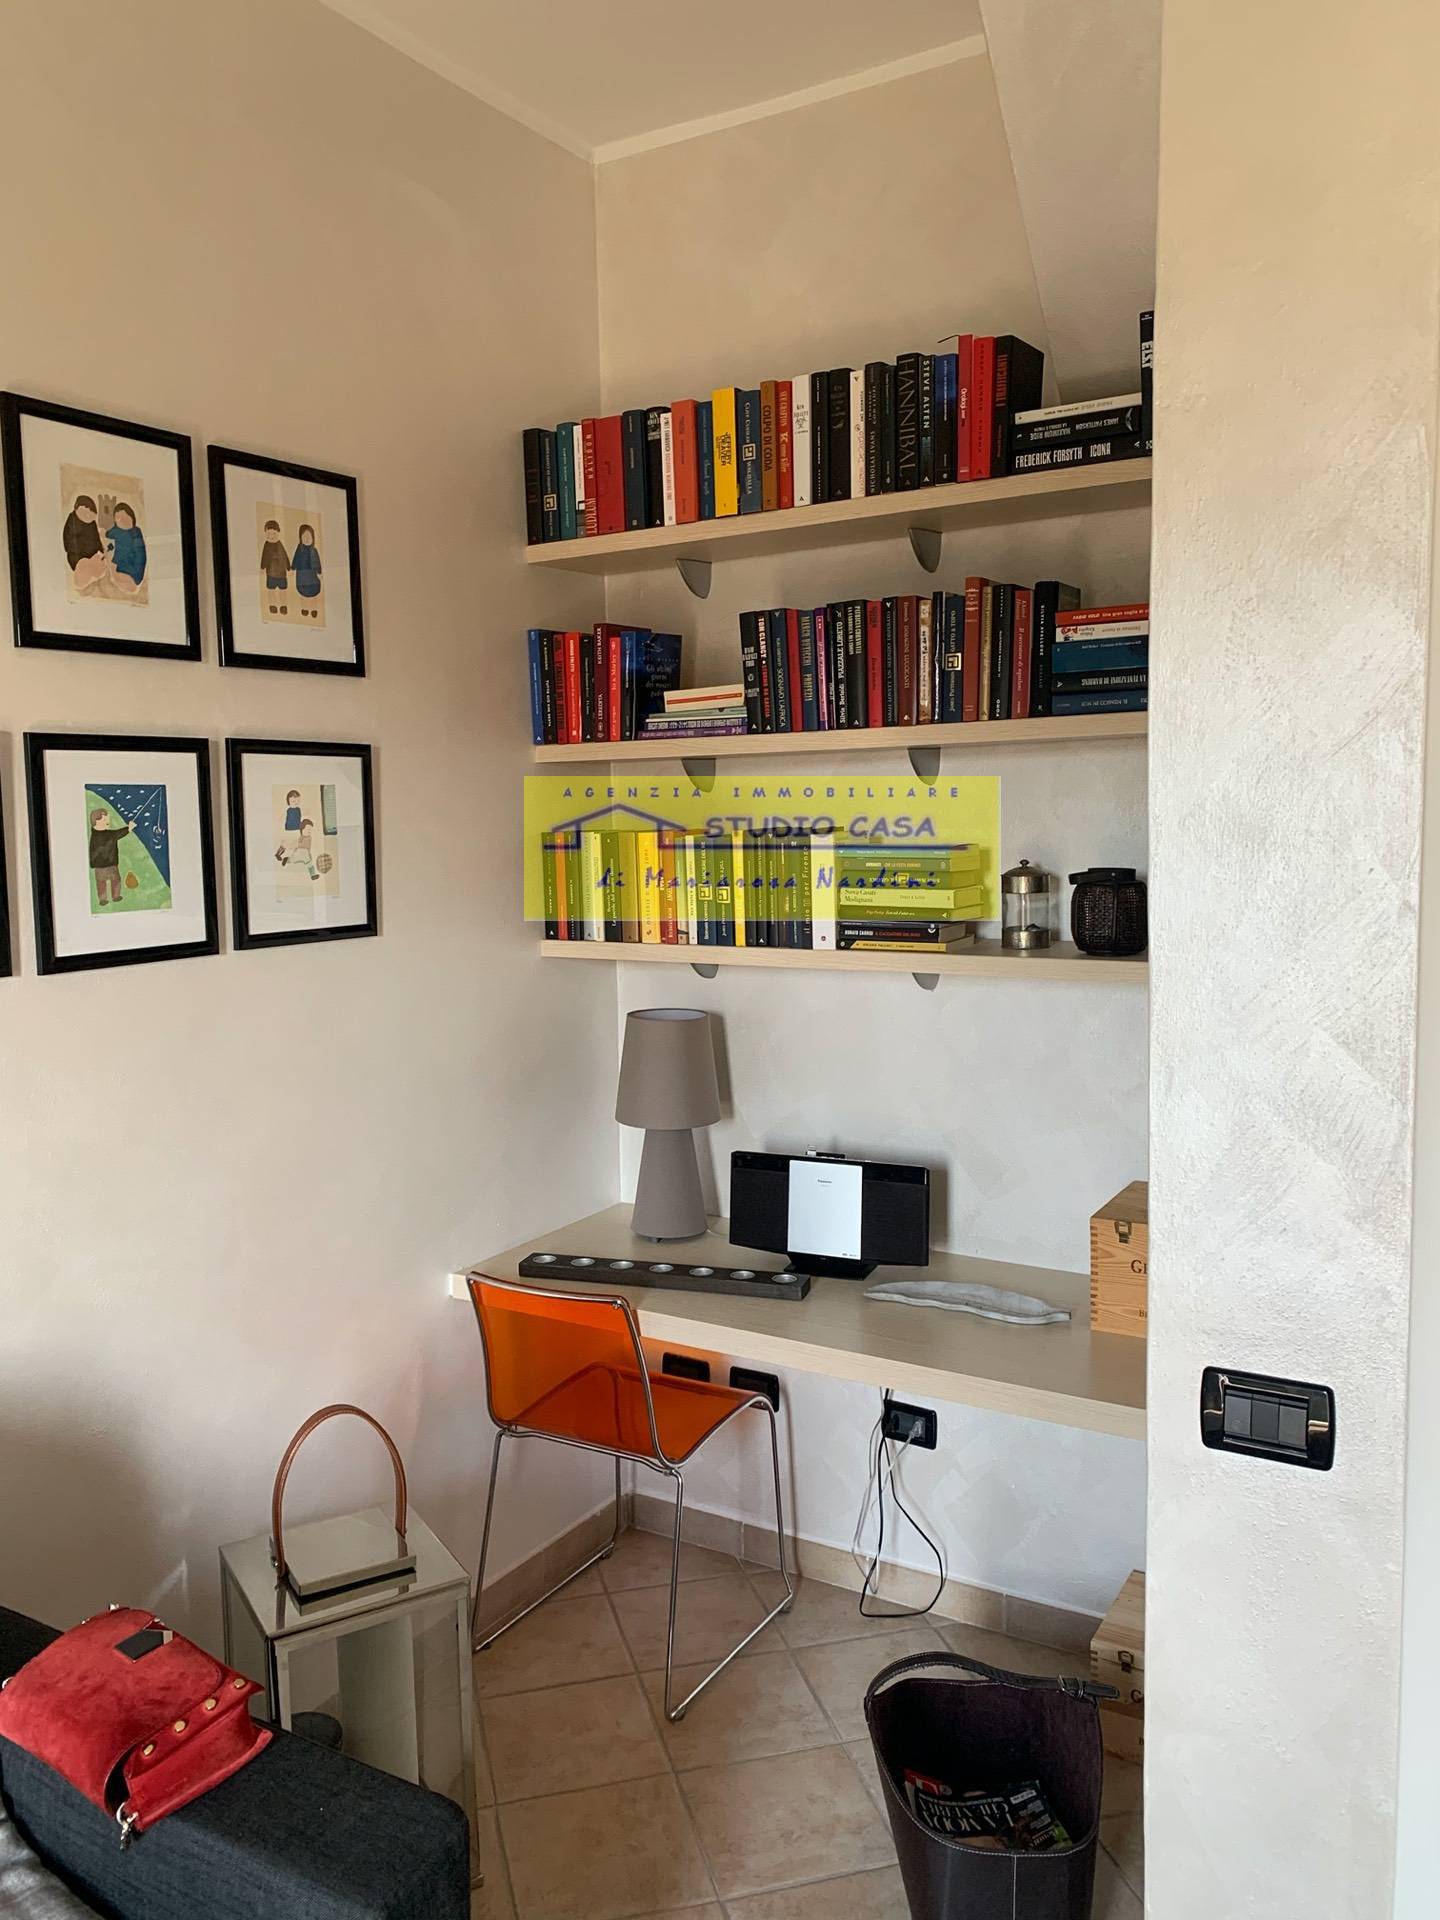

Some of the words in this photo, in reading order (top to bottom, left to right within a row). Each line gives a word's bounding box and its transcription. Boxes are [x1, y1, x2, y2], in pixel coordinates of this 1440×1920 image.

[960, 388, 968, 409] Orologi
[763, 405, 772, 433] COLPO
[899, 358, 915, 473] HANNIBAL
[1075, 421, 1102, 430] PATTERSON
[1103, 417, 1119, 425] JAMES
[764, 436, 772, 445] DI
[764, 448, 773, 471] CODA
[1015, 447, 1051, 468] FREDERICK
[1053, 446, 1083, 463] FORSYTH
[1090, 442, 1111, 457] ICONA
[585, 498, 597, 534] LUDLUM
[778, 700, 786, 727] L'AFRICA
